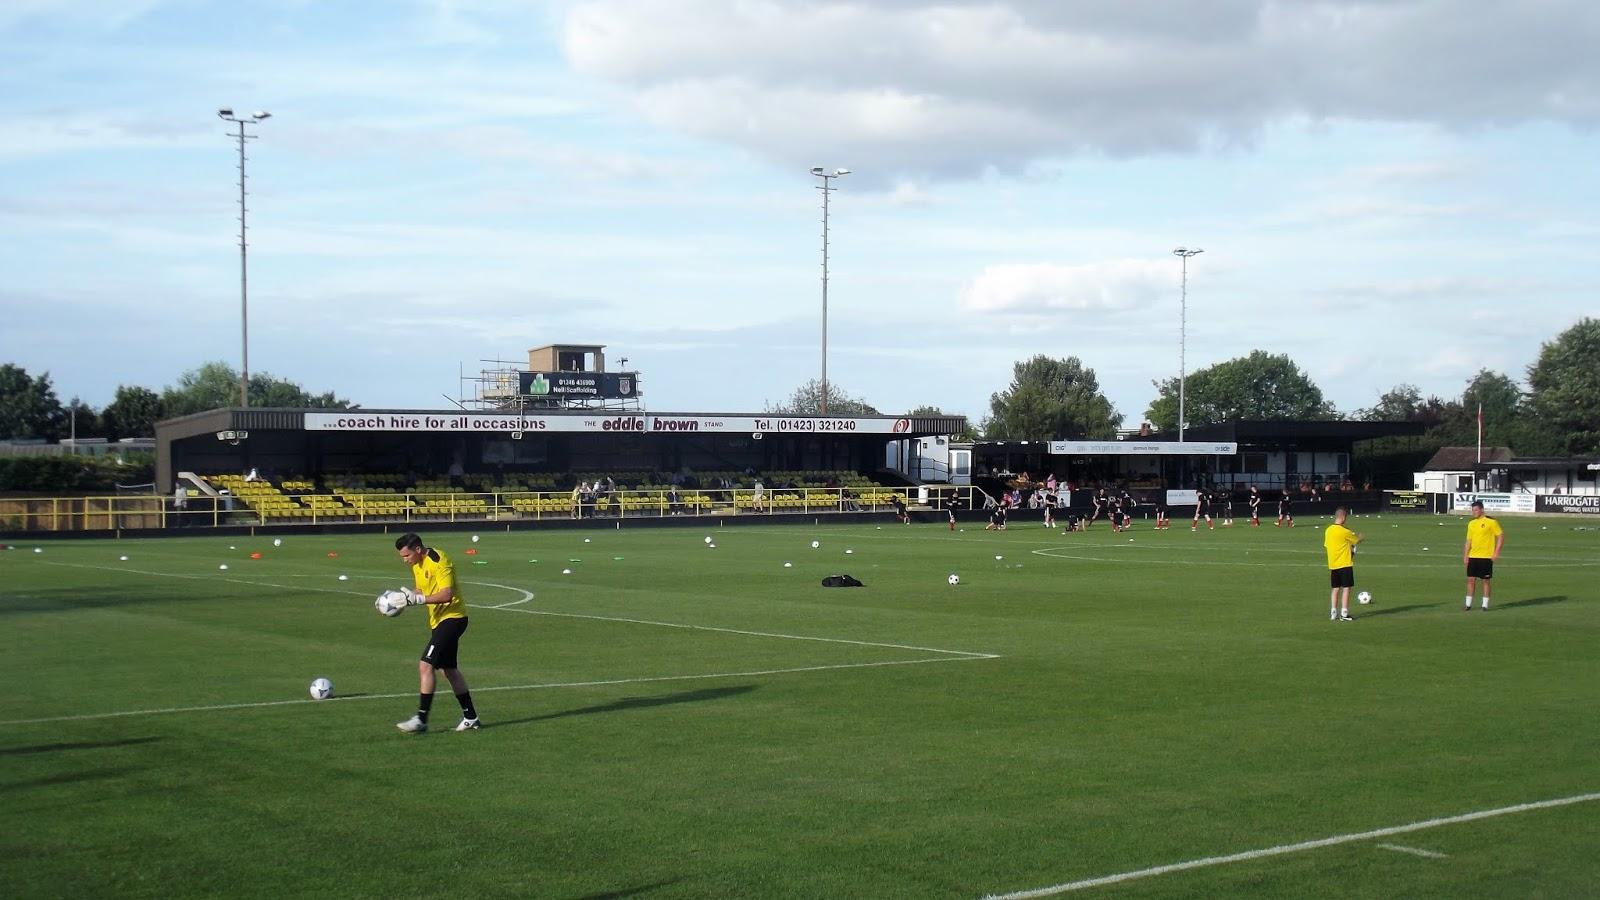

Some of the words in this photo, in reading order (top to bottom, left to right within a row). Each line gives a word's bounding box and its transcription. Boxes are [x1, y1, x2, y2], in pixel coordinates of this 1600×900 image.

[567, 386, 598, 395] Scaffolding
[391, 416, 420, 428] hire
[425, 416, 446, 429] for
[450, 417, 468, 429] all
[473, 417, 546, 430] occasions
[653, 417, 699, 431] brown
[754, 419, 774, 431] Tel.
[777, 419, 816, 432] (01423)
[819, 420, 856, 431] 321240
[1545, 496, 1600, 506] HARROGATE
